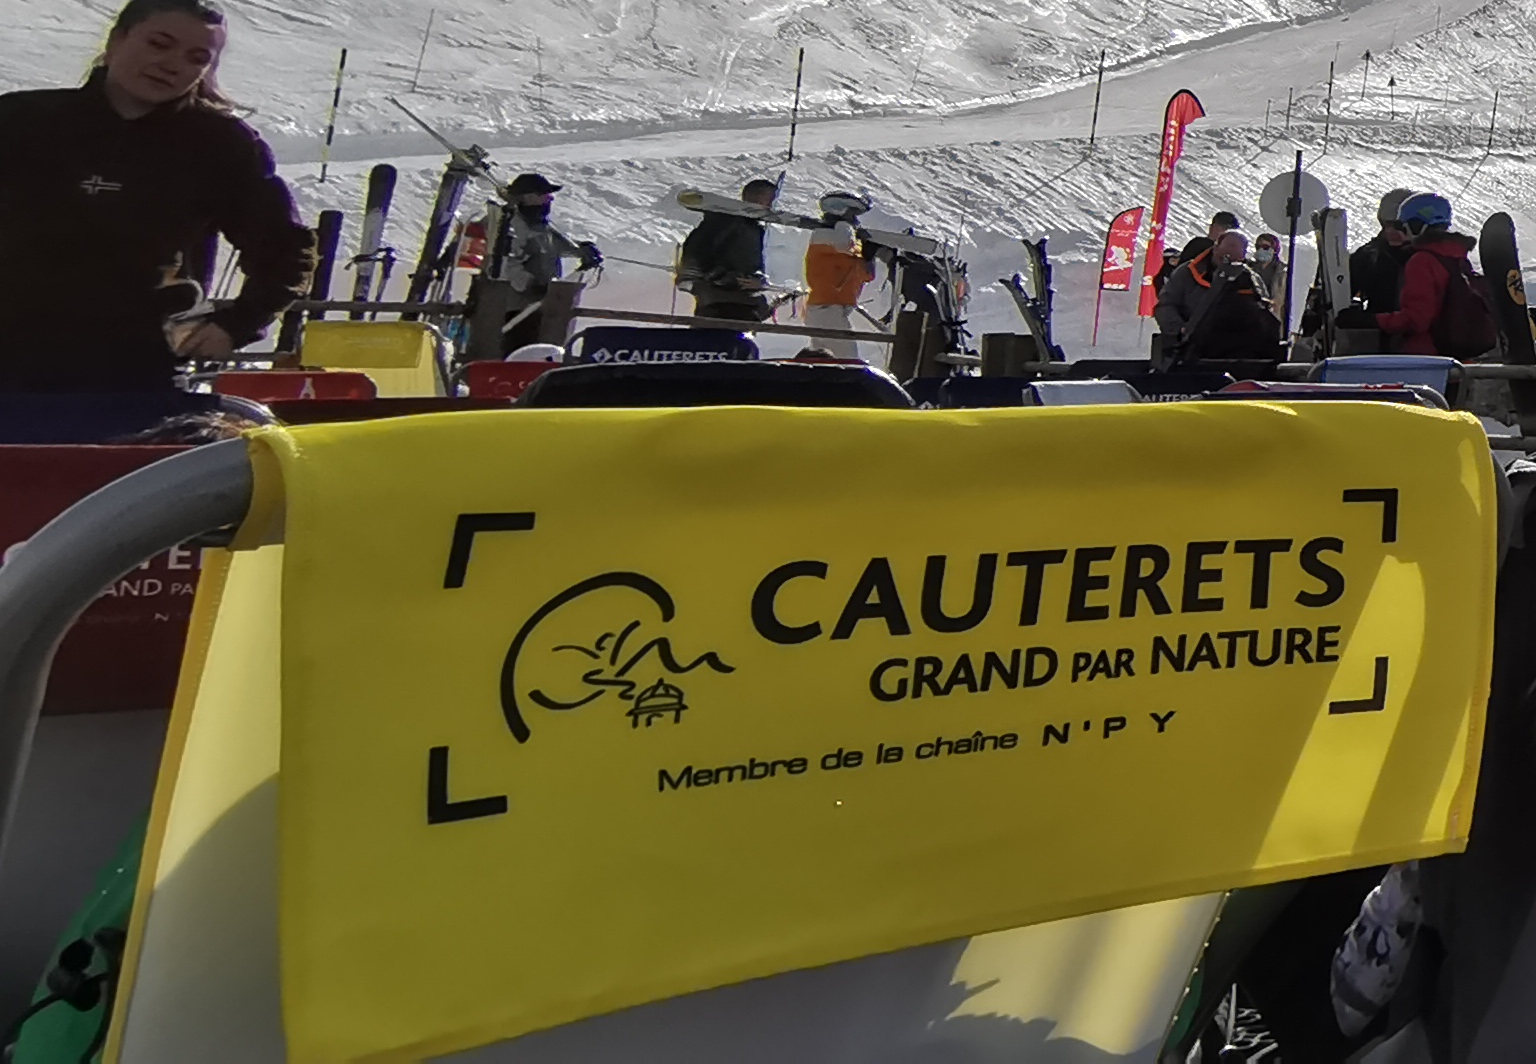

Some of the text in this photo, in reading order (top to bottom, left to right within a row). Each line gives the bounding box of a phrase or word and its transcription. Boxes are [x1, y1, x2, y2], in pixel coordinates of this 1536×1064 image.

[614, 349, 728, 363] CAUTERETS
[751, 537, 1345, 644] CAUTERETS
[869, 625, 1342, 702] GRAND PAR NATURE
[658, 755, 808, 793] Membre
[820, 747, 864, 771] de
[875, 742, 904, 765] la
[914, 729, 1019, 760] chaîne
